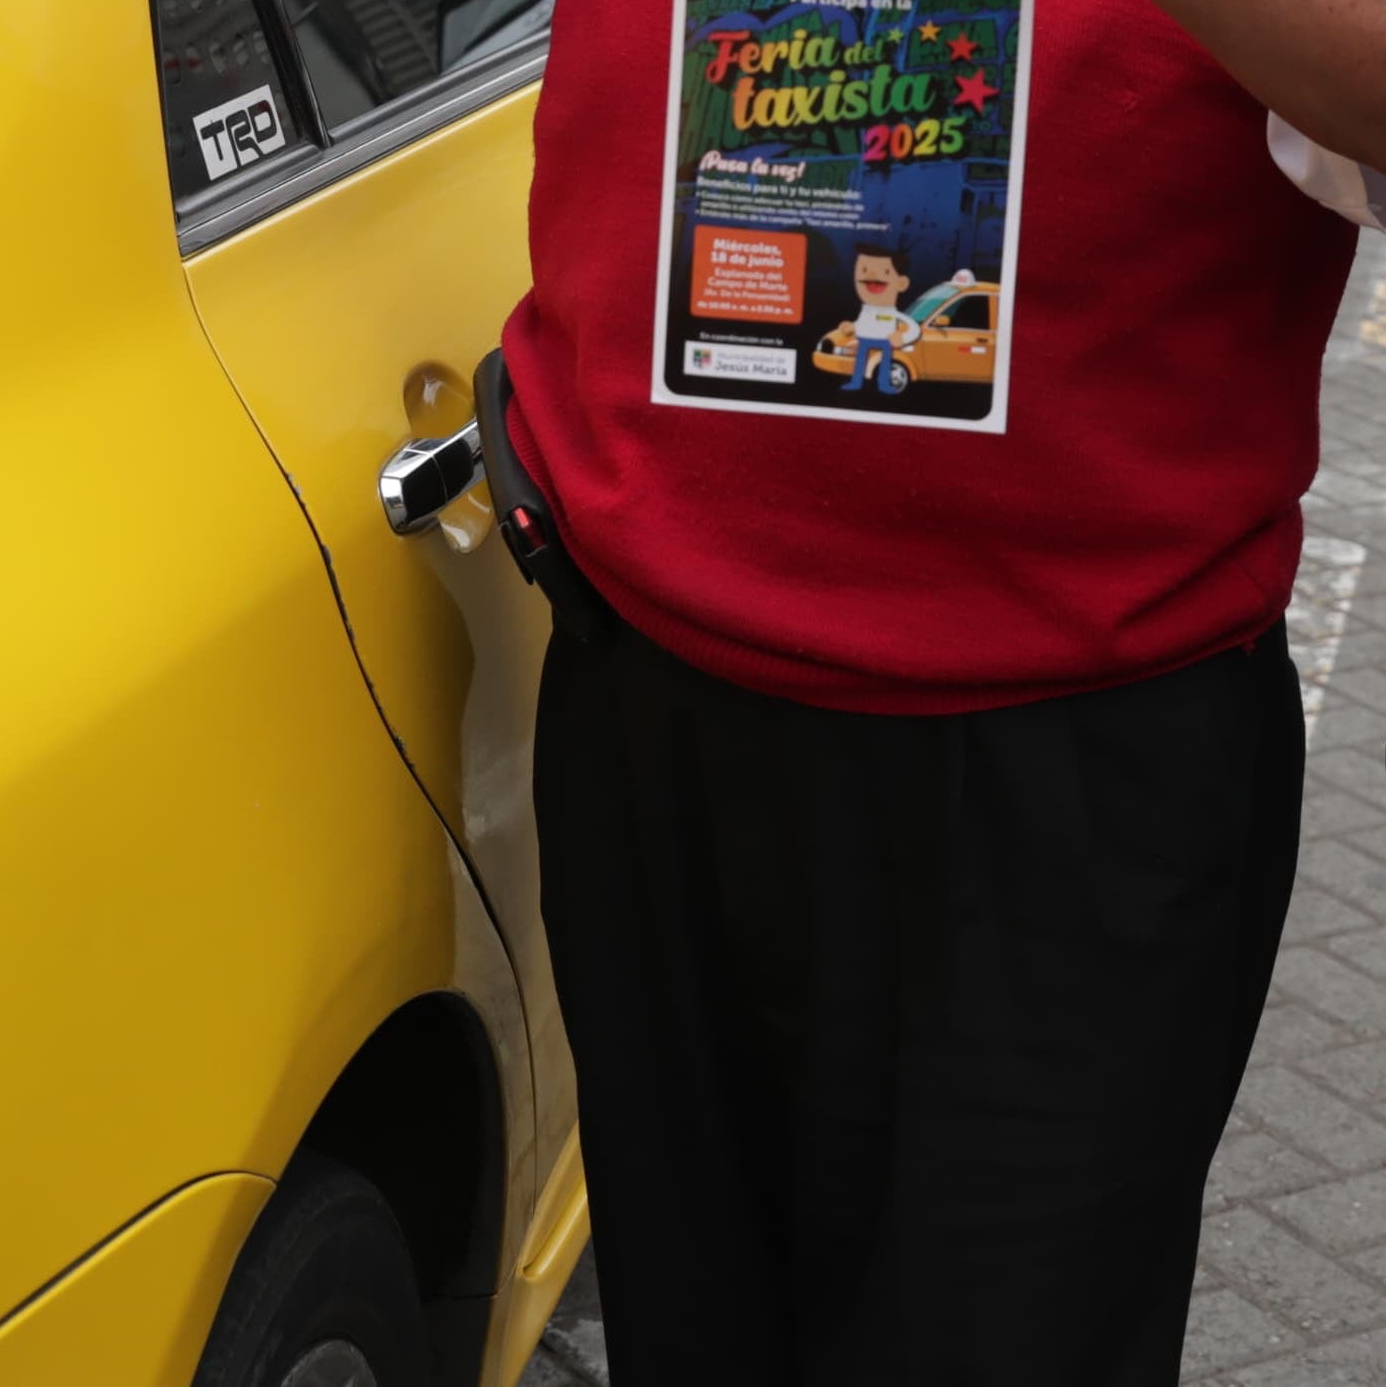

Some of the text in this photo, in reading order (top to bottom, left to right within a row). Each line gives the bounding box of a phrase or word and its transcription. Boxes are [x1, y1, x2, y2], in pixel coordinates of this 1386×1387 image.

[705, 28, 885, 84] Feria del
[732, 65, 936, 131] taxista
[862, 115, 968, 161] 2025
[710, 251, 784, 268] 18 de junio
